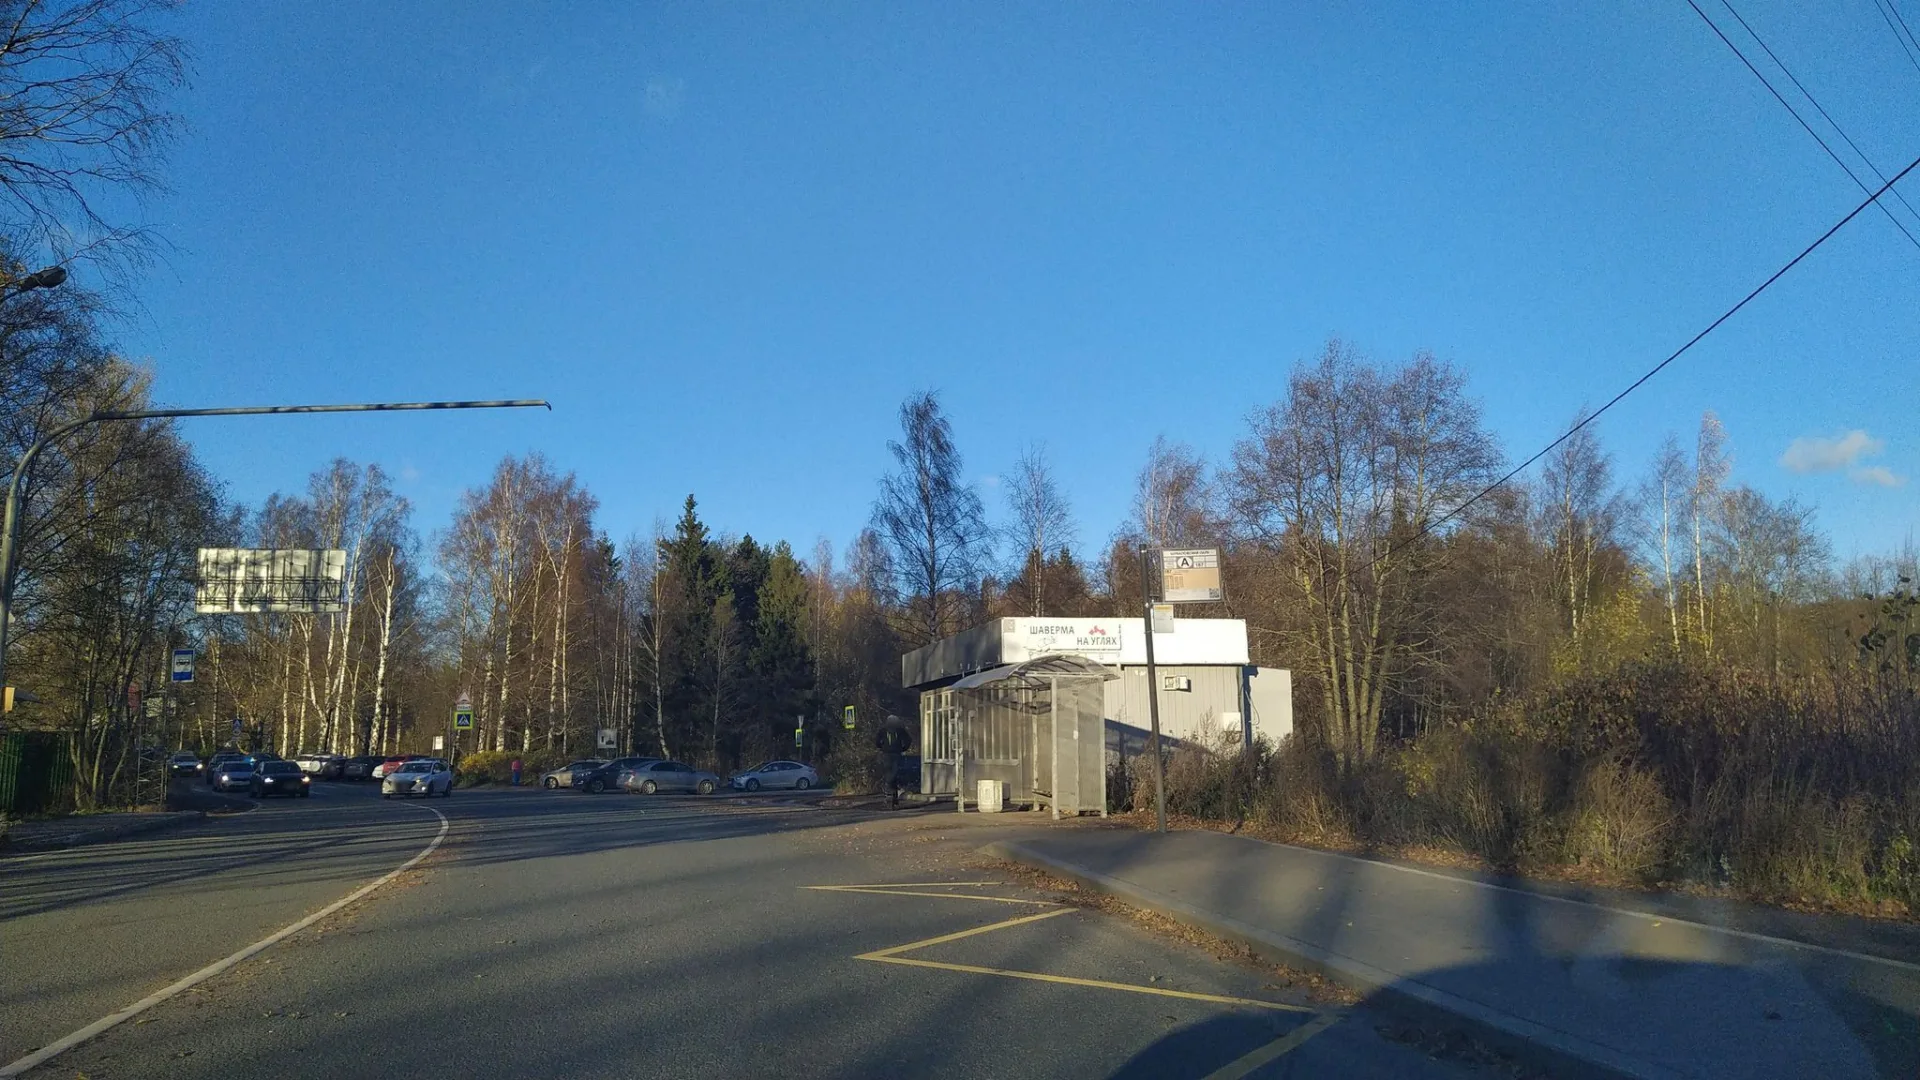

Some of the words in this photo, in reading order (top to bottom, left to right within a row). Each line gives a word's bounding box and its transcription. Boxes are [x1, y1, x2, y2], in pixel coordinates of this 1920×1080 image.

[1181, 557, 1190, 567] А
[1030, 625, 1075, 635] ШАВЕРМА
[1076, 637, 1089, 645] НА
[1091, 637, 1117, 646] УГЛЯХ
